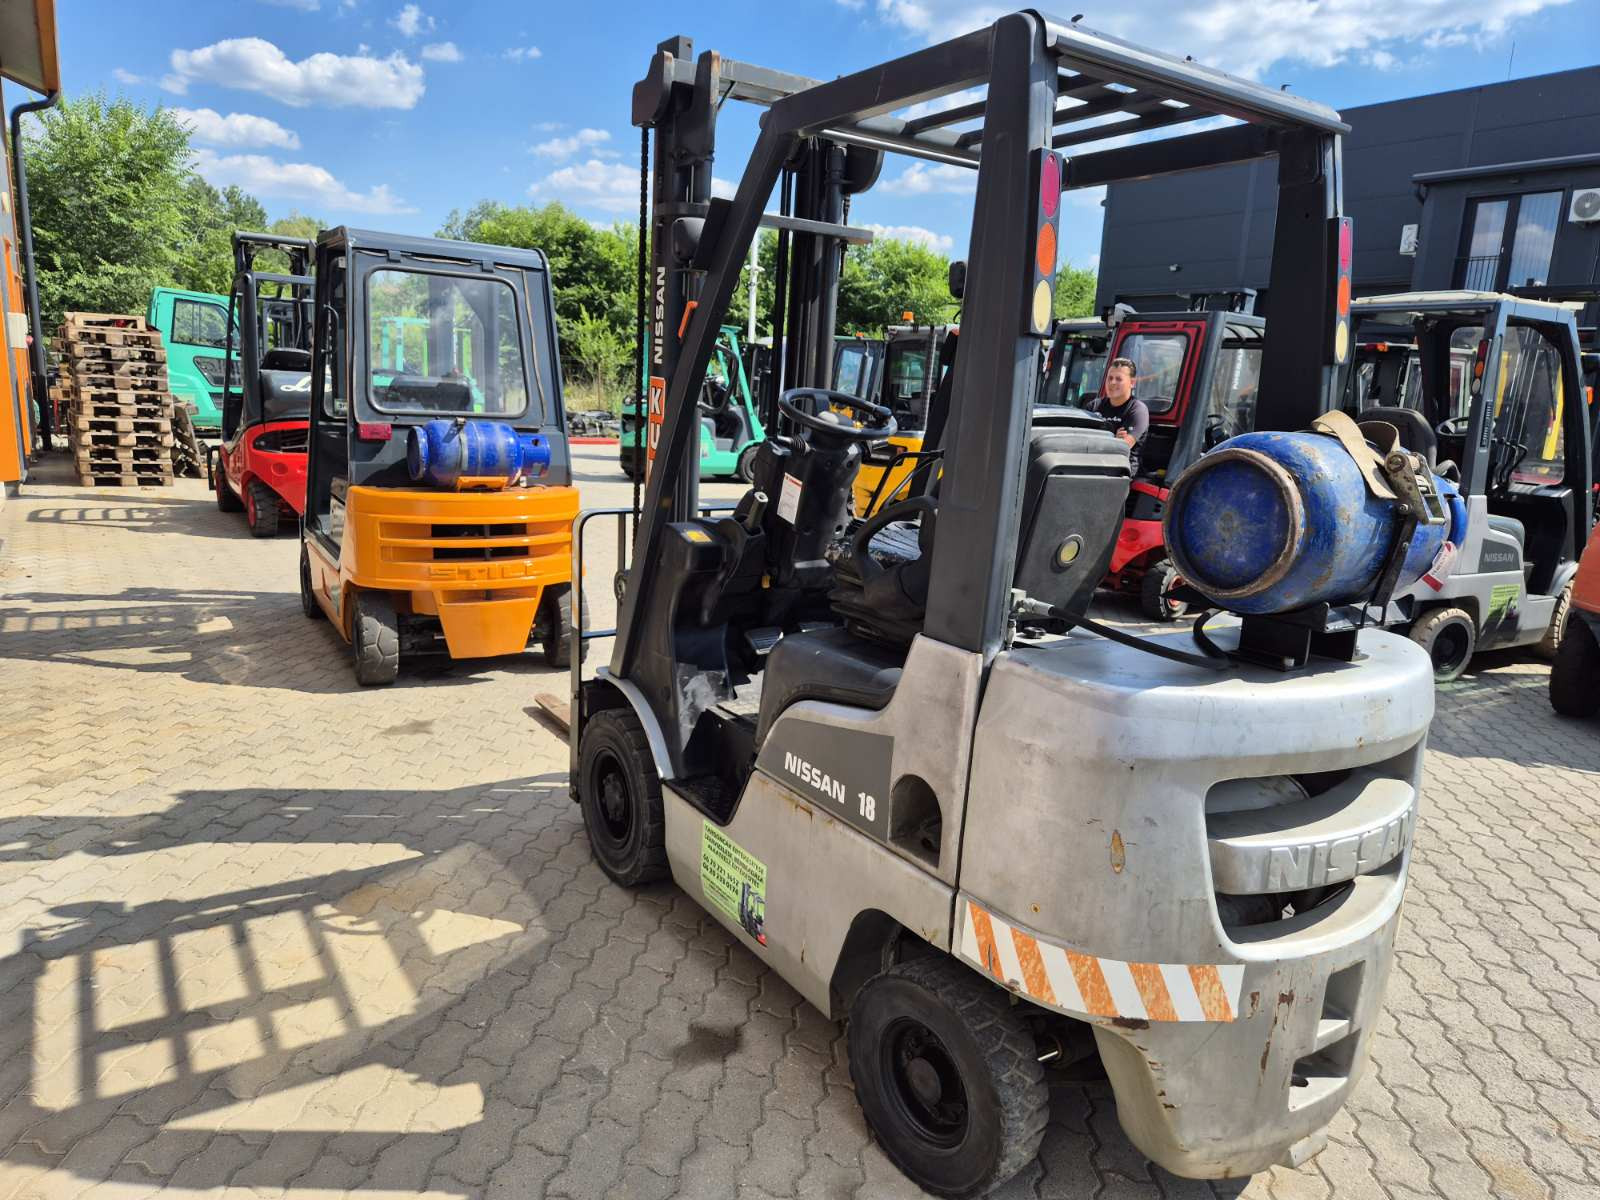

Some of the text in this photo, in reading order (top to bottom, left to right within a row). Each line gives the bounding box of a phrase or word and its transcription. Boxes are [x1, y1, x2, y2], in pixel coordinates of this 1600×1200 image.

[654, 266, 666, 364] NISSAN
[1484, 552, 1514, 562] NISSAN
[785, 751, 876, 822] NISSAN 18
